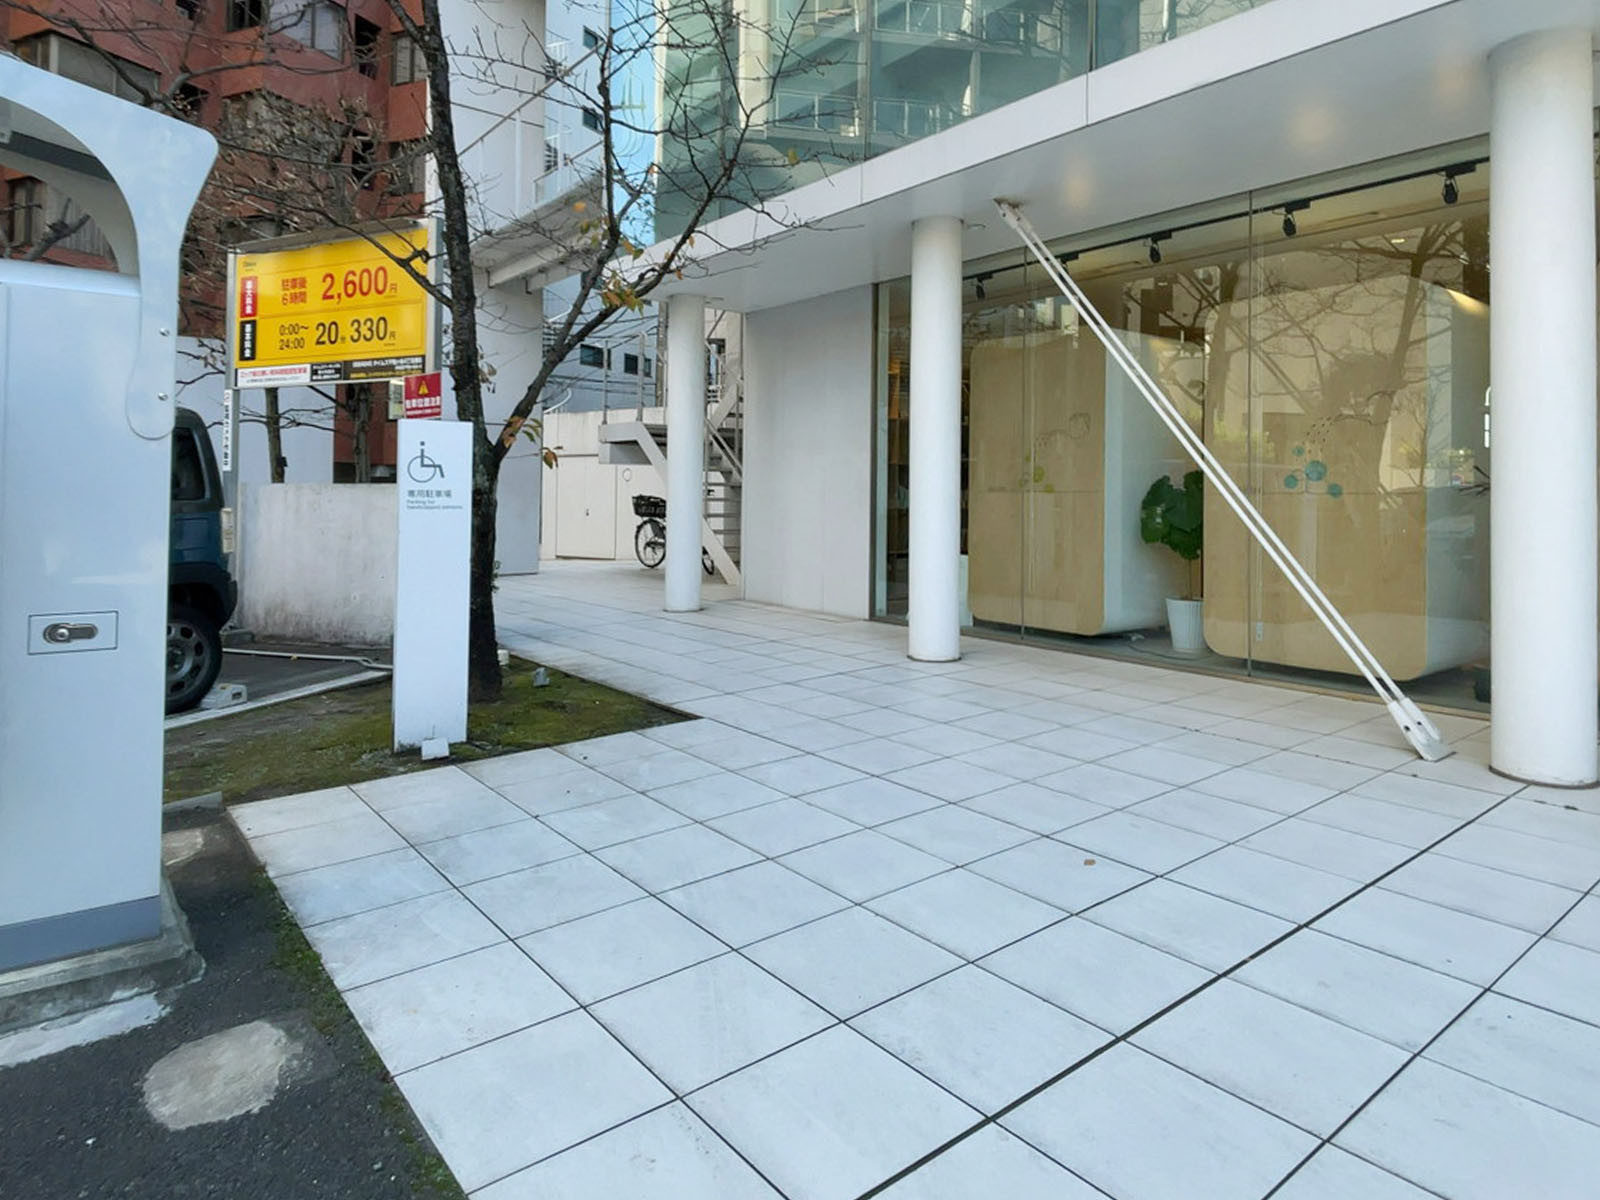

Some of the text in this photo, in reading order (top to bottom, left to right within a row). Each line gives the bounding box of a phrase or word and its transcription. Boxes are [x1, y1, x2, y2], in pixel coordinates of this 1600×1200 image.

[322, 266, 388, 304] 2,600
[281, 291, 307, 305] 6時間
[315, 321, 340, 345] 20
[350, 316, 388, 343] 330
[279, 337, 305, 350] 24:00
